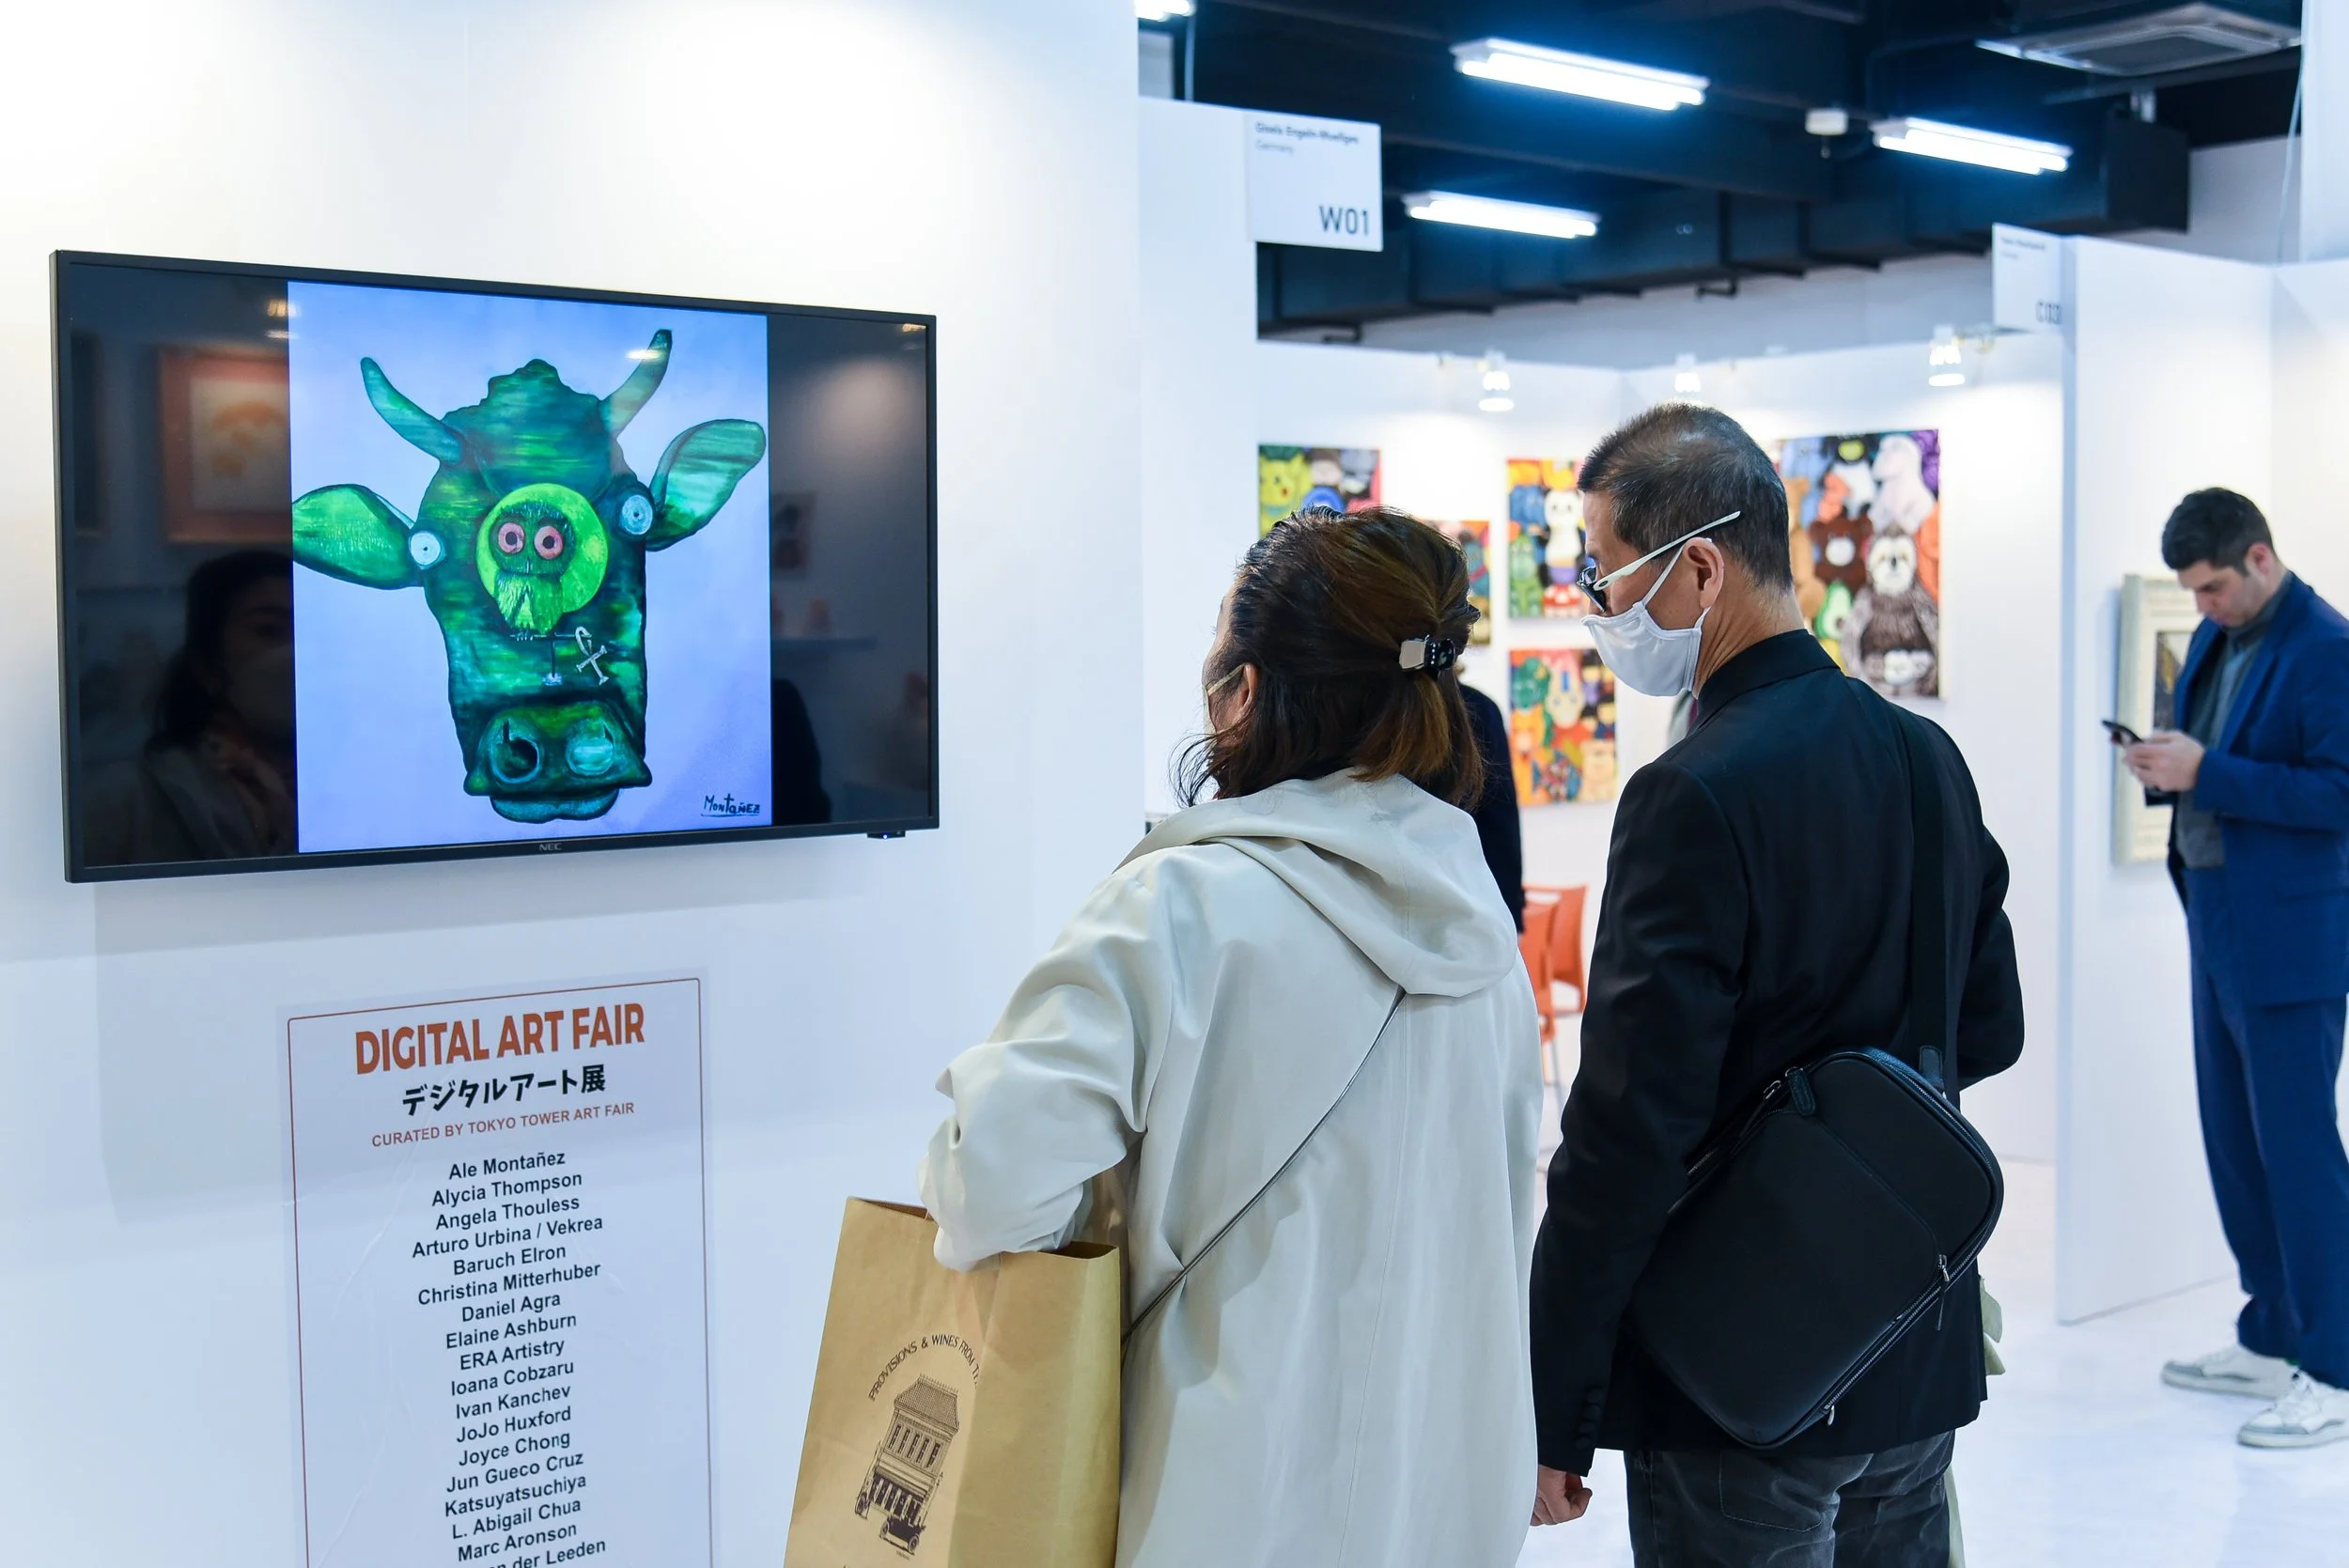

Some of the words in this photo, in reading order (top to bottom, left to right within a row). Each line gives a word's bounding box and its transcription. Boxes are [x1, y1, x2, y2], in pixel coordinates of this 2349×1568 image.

[1319, 206, 1369, 236] W01
[539, 843, 562, 851] NEC
[356, 1019, 490, 1075] DIGITAL
[497, 1011, 564, 1058] ART
[572, 1003, 645, 1049] FAIR
[402, 1063, 606, 1116] デジタルアート展
[372, 1127, 440, 1146] CURATED
[445, 1124, 463, 1137] BY
[468, 1117, 516, 1133] TOKYO
[521, 1110, 569, 1126] TOWER
[574, 1107, 600, 1120] ART
[605, 1103, 633, 1116] FAIR
[449, 1162, 476, 1180] Ale
[484, 1152, 566, 1175] Montañez
[432, 1186, 486, 1208] Alycia
[491, 1174, 582, 1197] Thompson
[436, 1207, 497, 1231] Angela
[502, 1198, 580, 1219] Thouless
[412, 1239, 469, 1258] Arturo
[475, 1228, 531, 1248] Urbina
[537, 1224, 543, 1239] /
[546, 1218, 602, 1236] Vekrea
[453, 1254, 516, 1276] Baruch
[521, 1247, 566, 1264] Elron
[418, 1281, 500, 1305] Christina
[504, 1265, 600, 1291] Mitterhuber
[462, 1298, 515, 1322] Daniel
[521, 1295, 560, 1313] Agra
[446, 1328, 499, 1349] Elaine
[504, 1315, 576, 1338] Ashburn
[460, 1350, 498, 1370] ERA
[502, 1341, 565, 1362] Artistry
[868, 1341, 917, 1401] PROVISIONS
[921, 1337, 928, 1349] &
[931, 1334, 959, 1347] WINES
[451, 1377, 498, 1396] Ioana
[504, 1362, 573, 1385] Cobzaru
[457, 1402, 491, 1419] Ivan
[498, 1386, 570, 1410] Kanchev
[457, 1422, 499, 1442] JoJo
[505, 1405, 570, 1433] Huxford
[459, 1446, 509, 1466] Joyce
[516, 1433, 570, 1453] Chong
[446, 1476, 478, 1493] Jun
[486, 1463, 540, 1483] Gueco
[546, 1453, 583, 1471] Cruz
[445, 1474, 587, 1517] Katsuyatsuchiya
[453, 1525, 467, 1539] L.
[473, 1509, 533, 1536] Abigail
[538, 1500, 581, 1519] Chua
[459, 1543, 500, 1561] Marc
[505, 1525, 576, 1551] Aronson
[513, 1556, 540, 1568] der
[547, 1541, 605, 1565] Leeden
